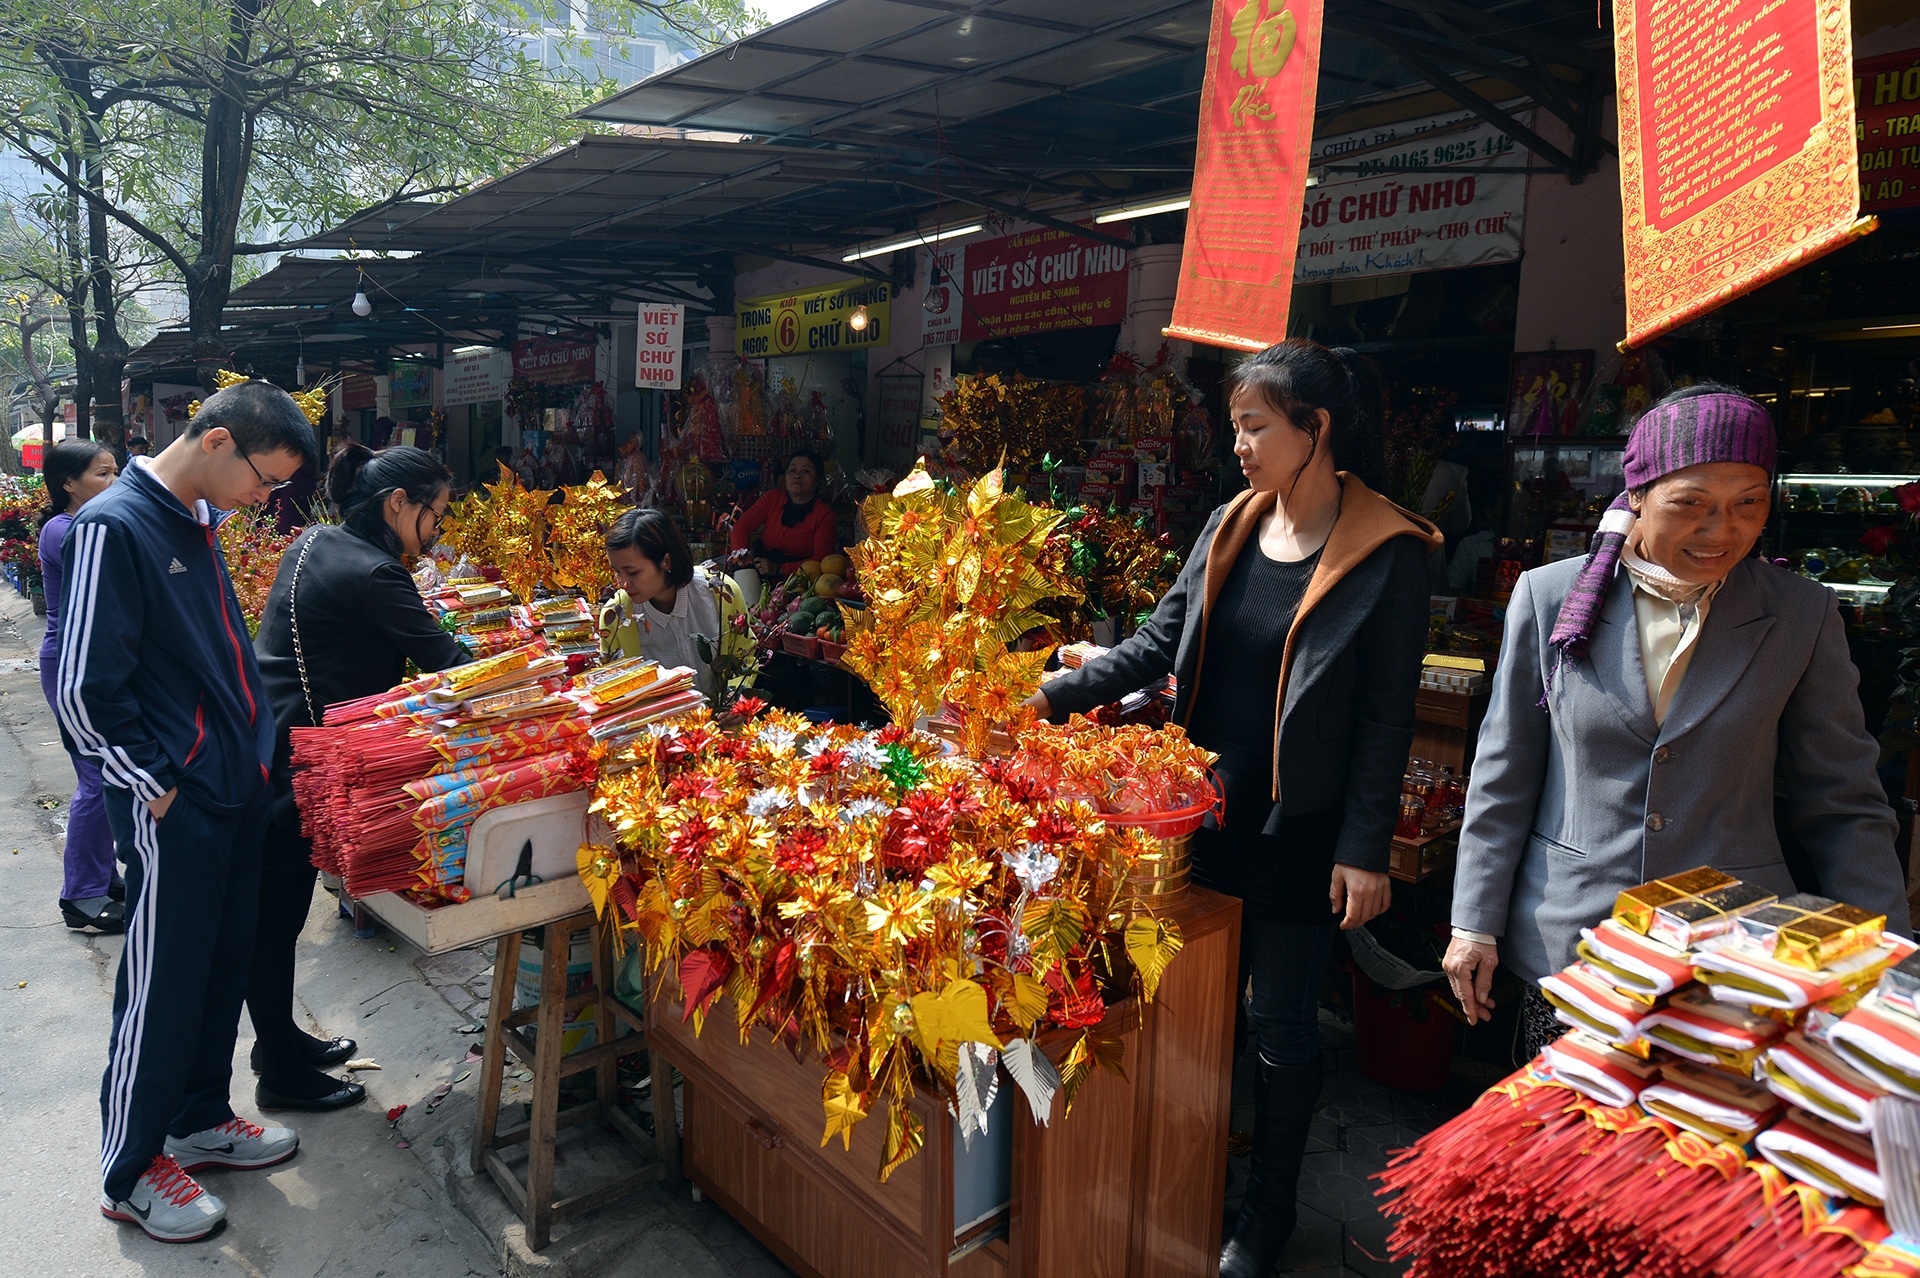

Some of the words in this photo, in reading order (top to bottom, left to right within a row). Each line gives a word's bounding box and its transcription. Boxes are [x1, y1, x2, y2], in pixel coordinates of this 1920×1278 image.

[1672, 38, 1688, 54] con
[1654, 93, 1672, 108] Con
[1655, 101, 1678, 122] Anh
[1680, 92, 1694, 105] em
[1656, 113, 1684, 136] Trong
[1756, 122, 1783, 145] nhẫn
[1434, 140, 1477, 164] 9625
[1481, 133, 1515, 155] 442
[1861, 146, 1894, 172] ĐÀI
[1658, 175, 1674, 191] Ai
[1676, 168, 1686, 181] ai
[1711, 176, 1721, 189] là
[1876, 176, 1904, 201] ÁO
[1338, 181, 1404, 223] CHỮ
[1408, 176, 1476, 214] NHO
[1309, 233, 1334, 258] ĐỐI
[1348, 231, 1379, 252] THƯ
[1380, 225, 1422, 248] PHÁP
[1437, 221, 1469, 241] CHO
[1475, 211, 1512, 235] CHỮ
[971, 255, 1008, 296] VIẾT
[1011, 251, 1038, 289] SỚ
[1040, 243, 1082, 284] CHỮ
[803, 293, 827, 315] VIẾT
[829, 290, 845, 311] SỚ
[643, 308, 679, 326] VIẾT
[740, 307, 771, 330] TRỌNG
[645, 327, 669, 345] SỚ
[780, 316, 795, 347] 6
[808, 318, 842, 349] CHỮ
[572, 346, 592, 362] NHO
[640, 345, 676, 364] CHỮ
[742, 335, 769, 357] NGỌC
[640, 367, 674, 382] NHO
[933, 367, 942, 390] 5
[168, 566, 187, 574] adidas
